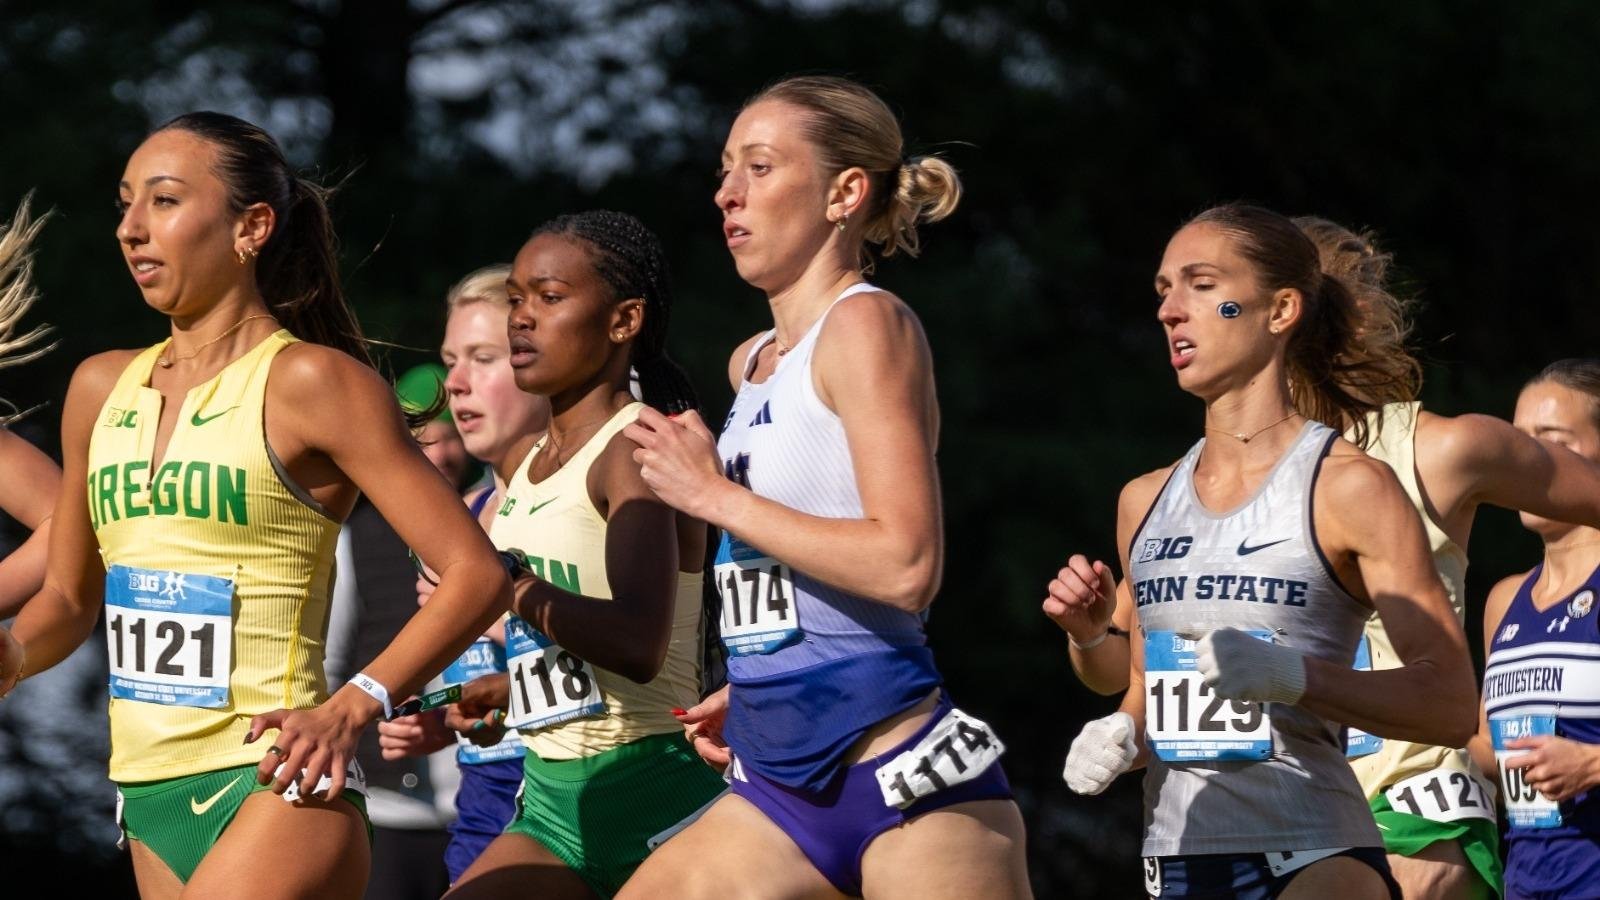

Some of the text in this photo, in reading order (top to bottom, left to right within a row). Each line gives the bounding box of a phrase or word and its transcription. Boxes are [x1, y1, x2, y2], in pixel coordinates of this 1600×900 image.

[1139, 535, 1193, 563] BIG
[129, 573, 159, 592] BIG
[1133, 574, 1308, 608] ENN STATE
[110, 614, 215, 678] 1121
[1151, 678, 1263, 733] 1129
[888, 720, 992, 802] 1174
